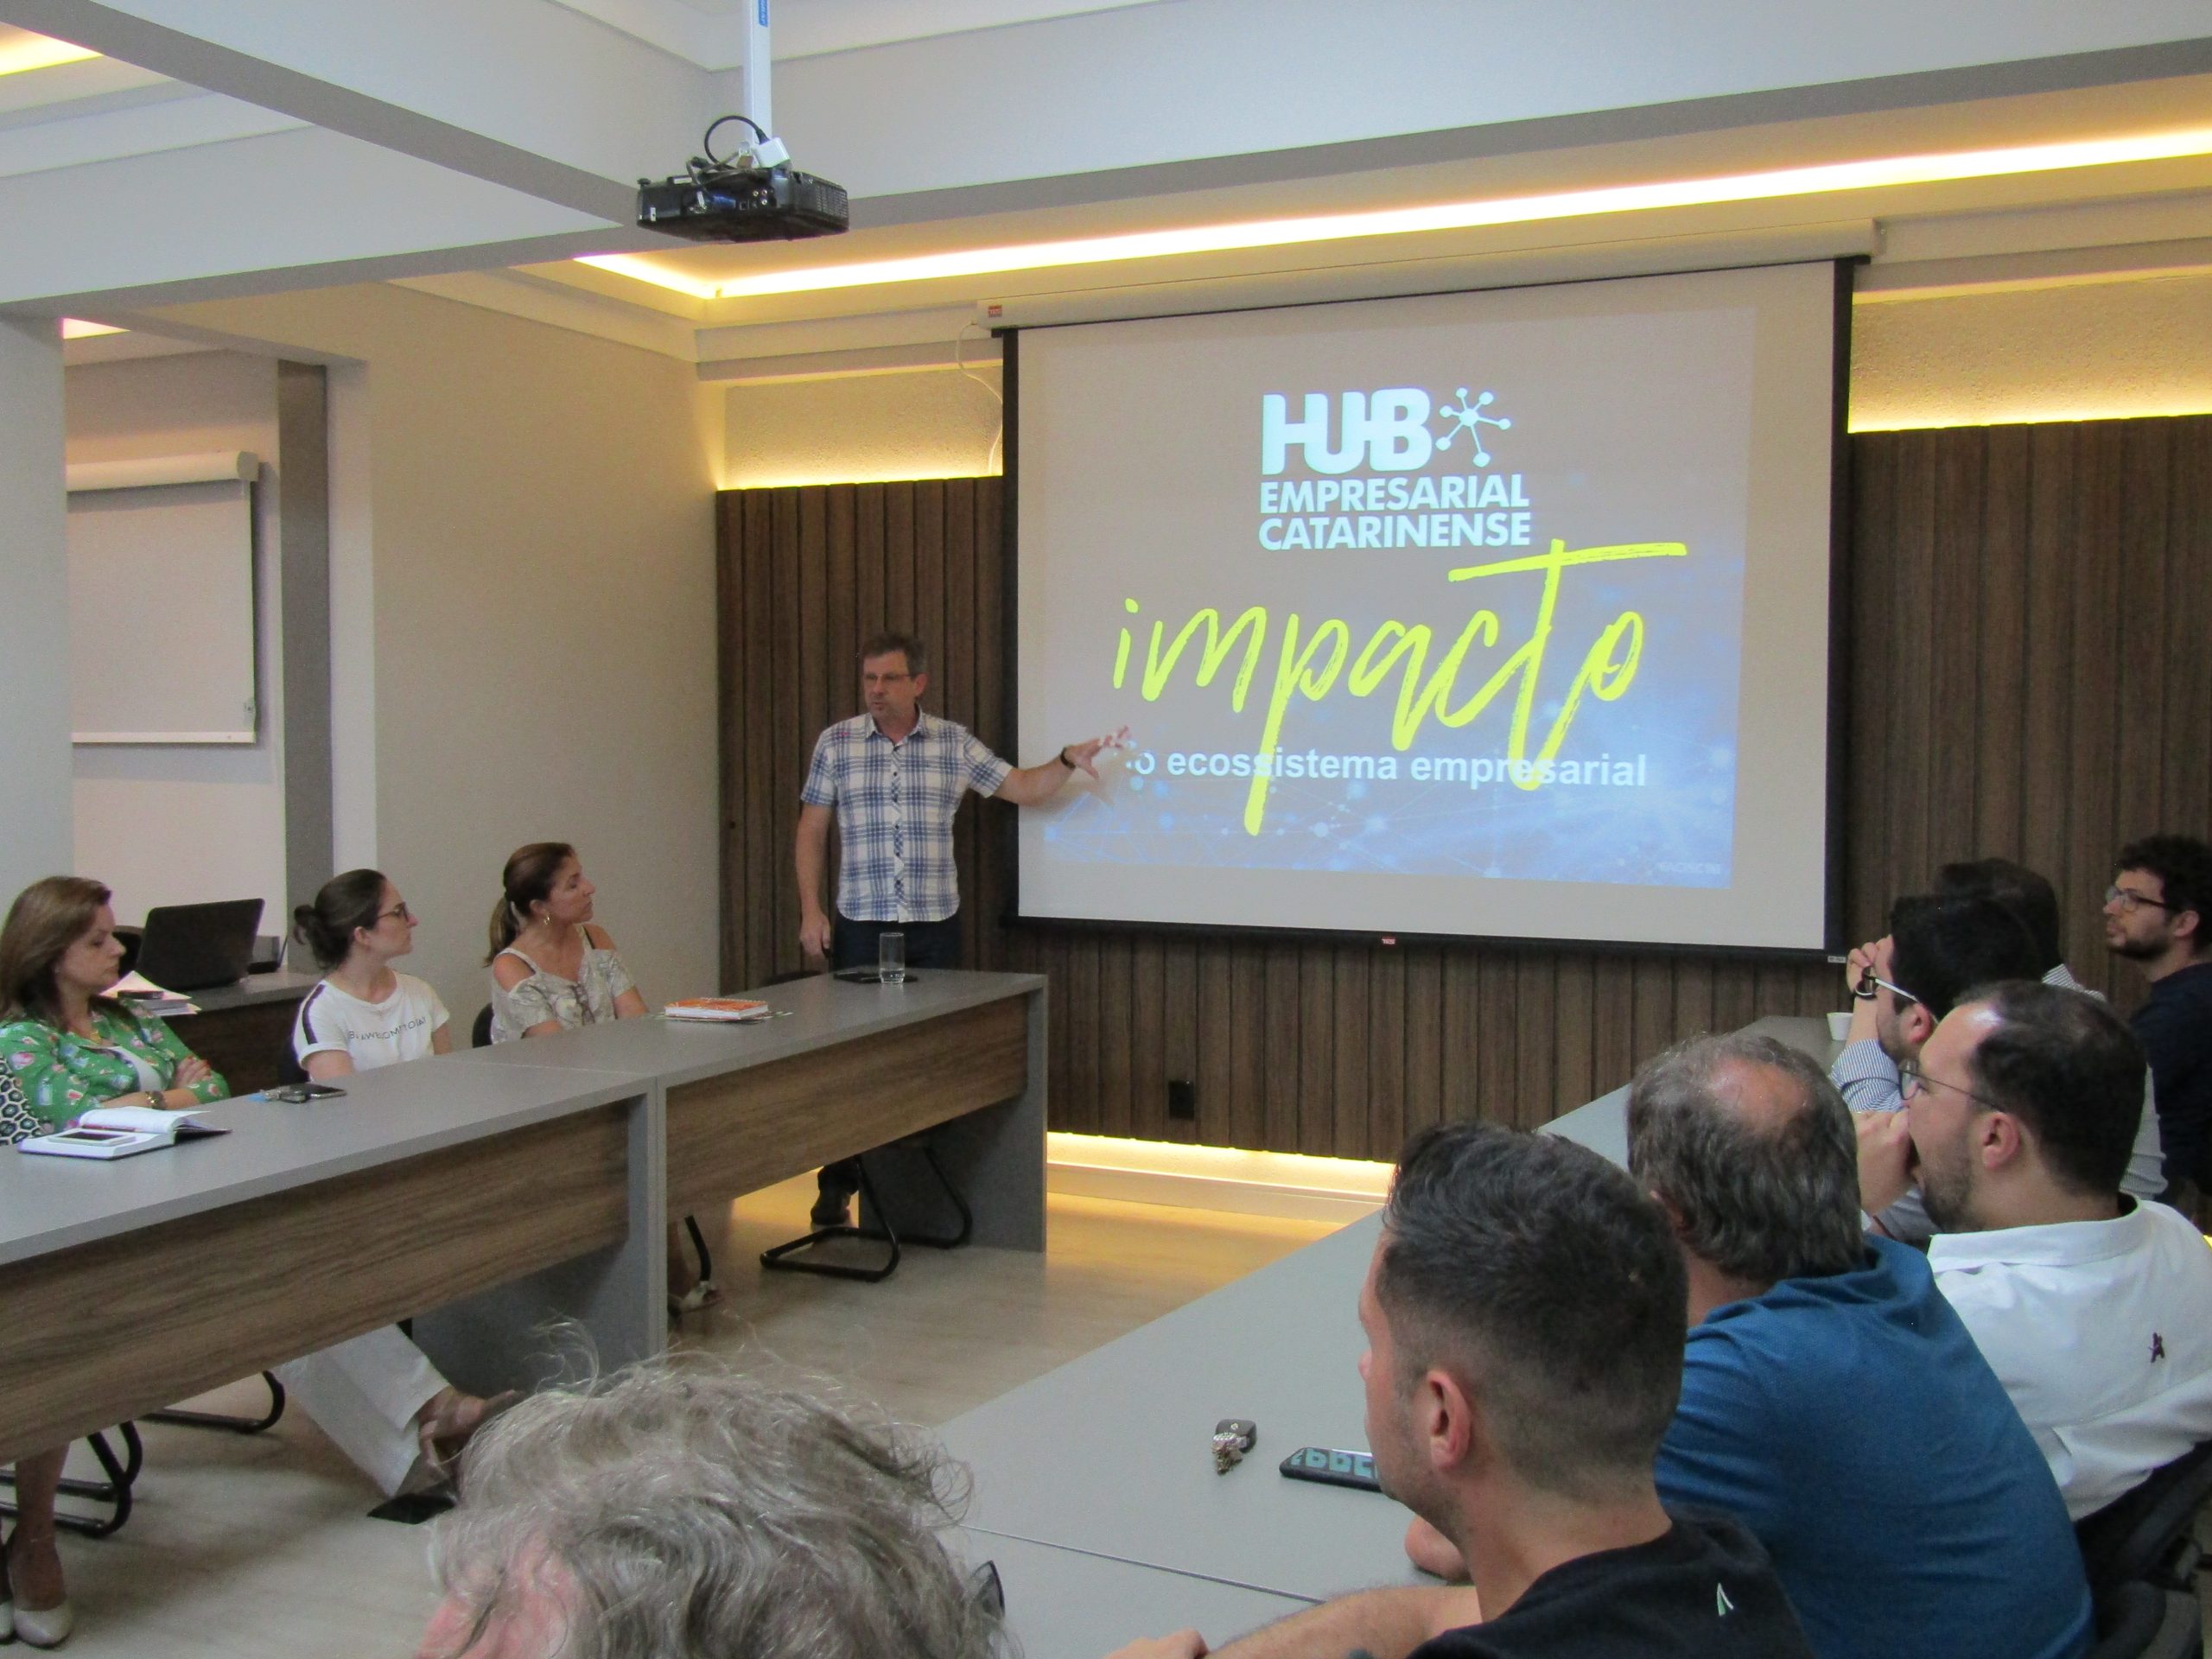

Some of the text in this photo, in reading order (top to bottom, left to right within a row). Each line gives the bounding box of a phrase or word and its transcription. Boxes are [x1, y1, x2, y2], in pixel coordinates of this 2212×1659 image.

[1262, 387, 1433, 475] HUB
[1260, 474, 1530, 513] EMPRESARIAL
[1258, 512, 1532, 550] CATARINENSE
[1113, 538, 1688, 836] impacto
[1166, 747, 1398, 779] ecossistema
[1410, 753, 1646, 790] empresarial
